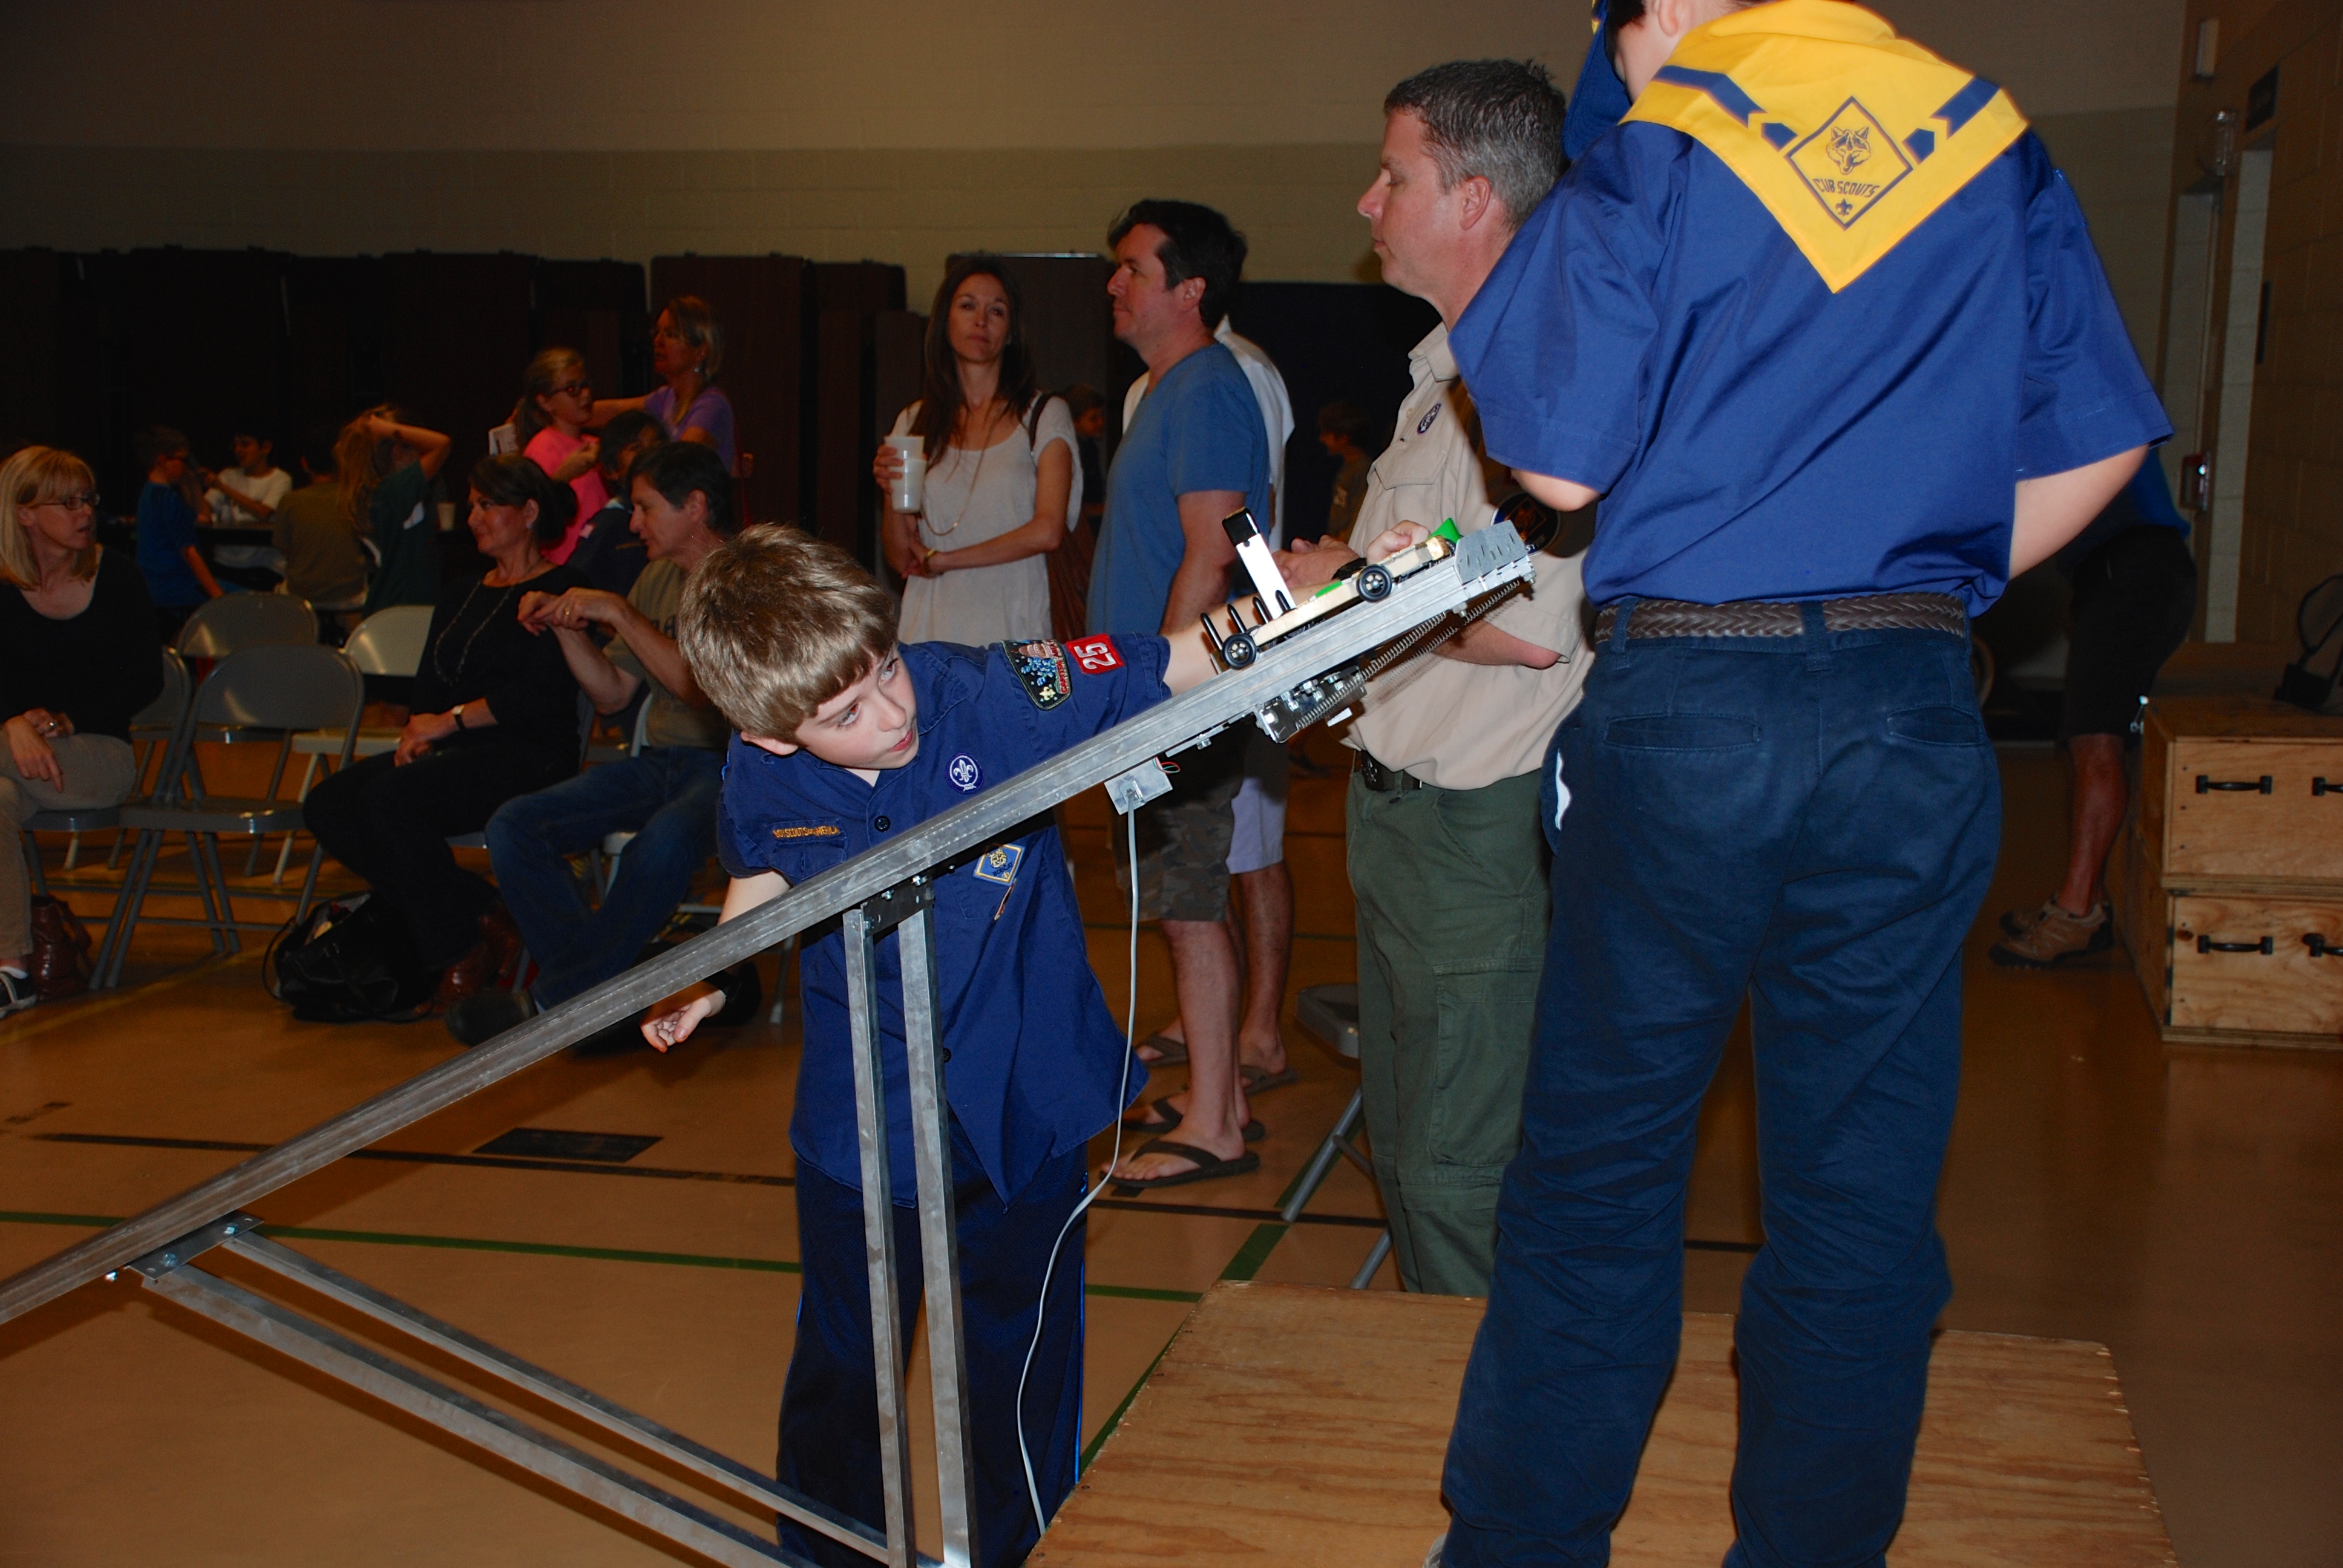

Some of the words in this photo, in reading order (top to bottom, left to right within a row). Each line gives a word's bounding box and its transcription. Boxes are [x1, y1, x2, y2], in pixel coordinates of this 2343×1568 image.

[1812, 178, 1835, 193] CUB
[1837, 180, 1881, 198] SCOUTS
[1073, 642, 1116, 670] 25
[992, 861, 1014, 877] BOBCAT
